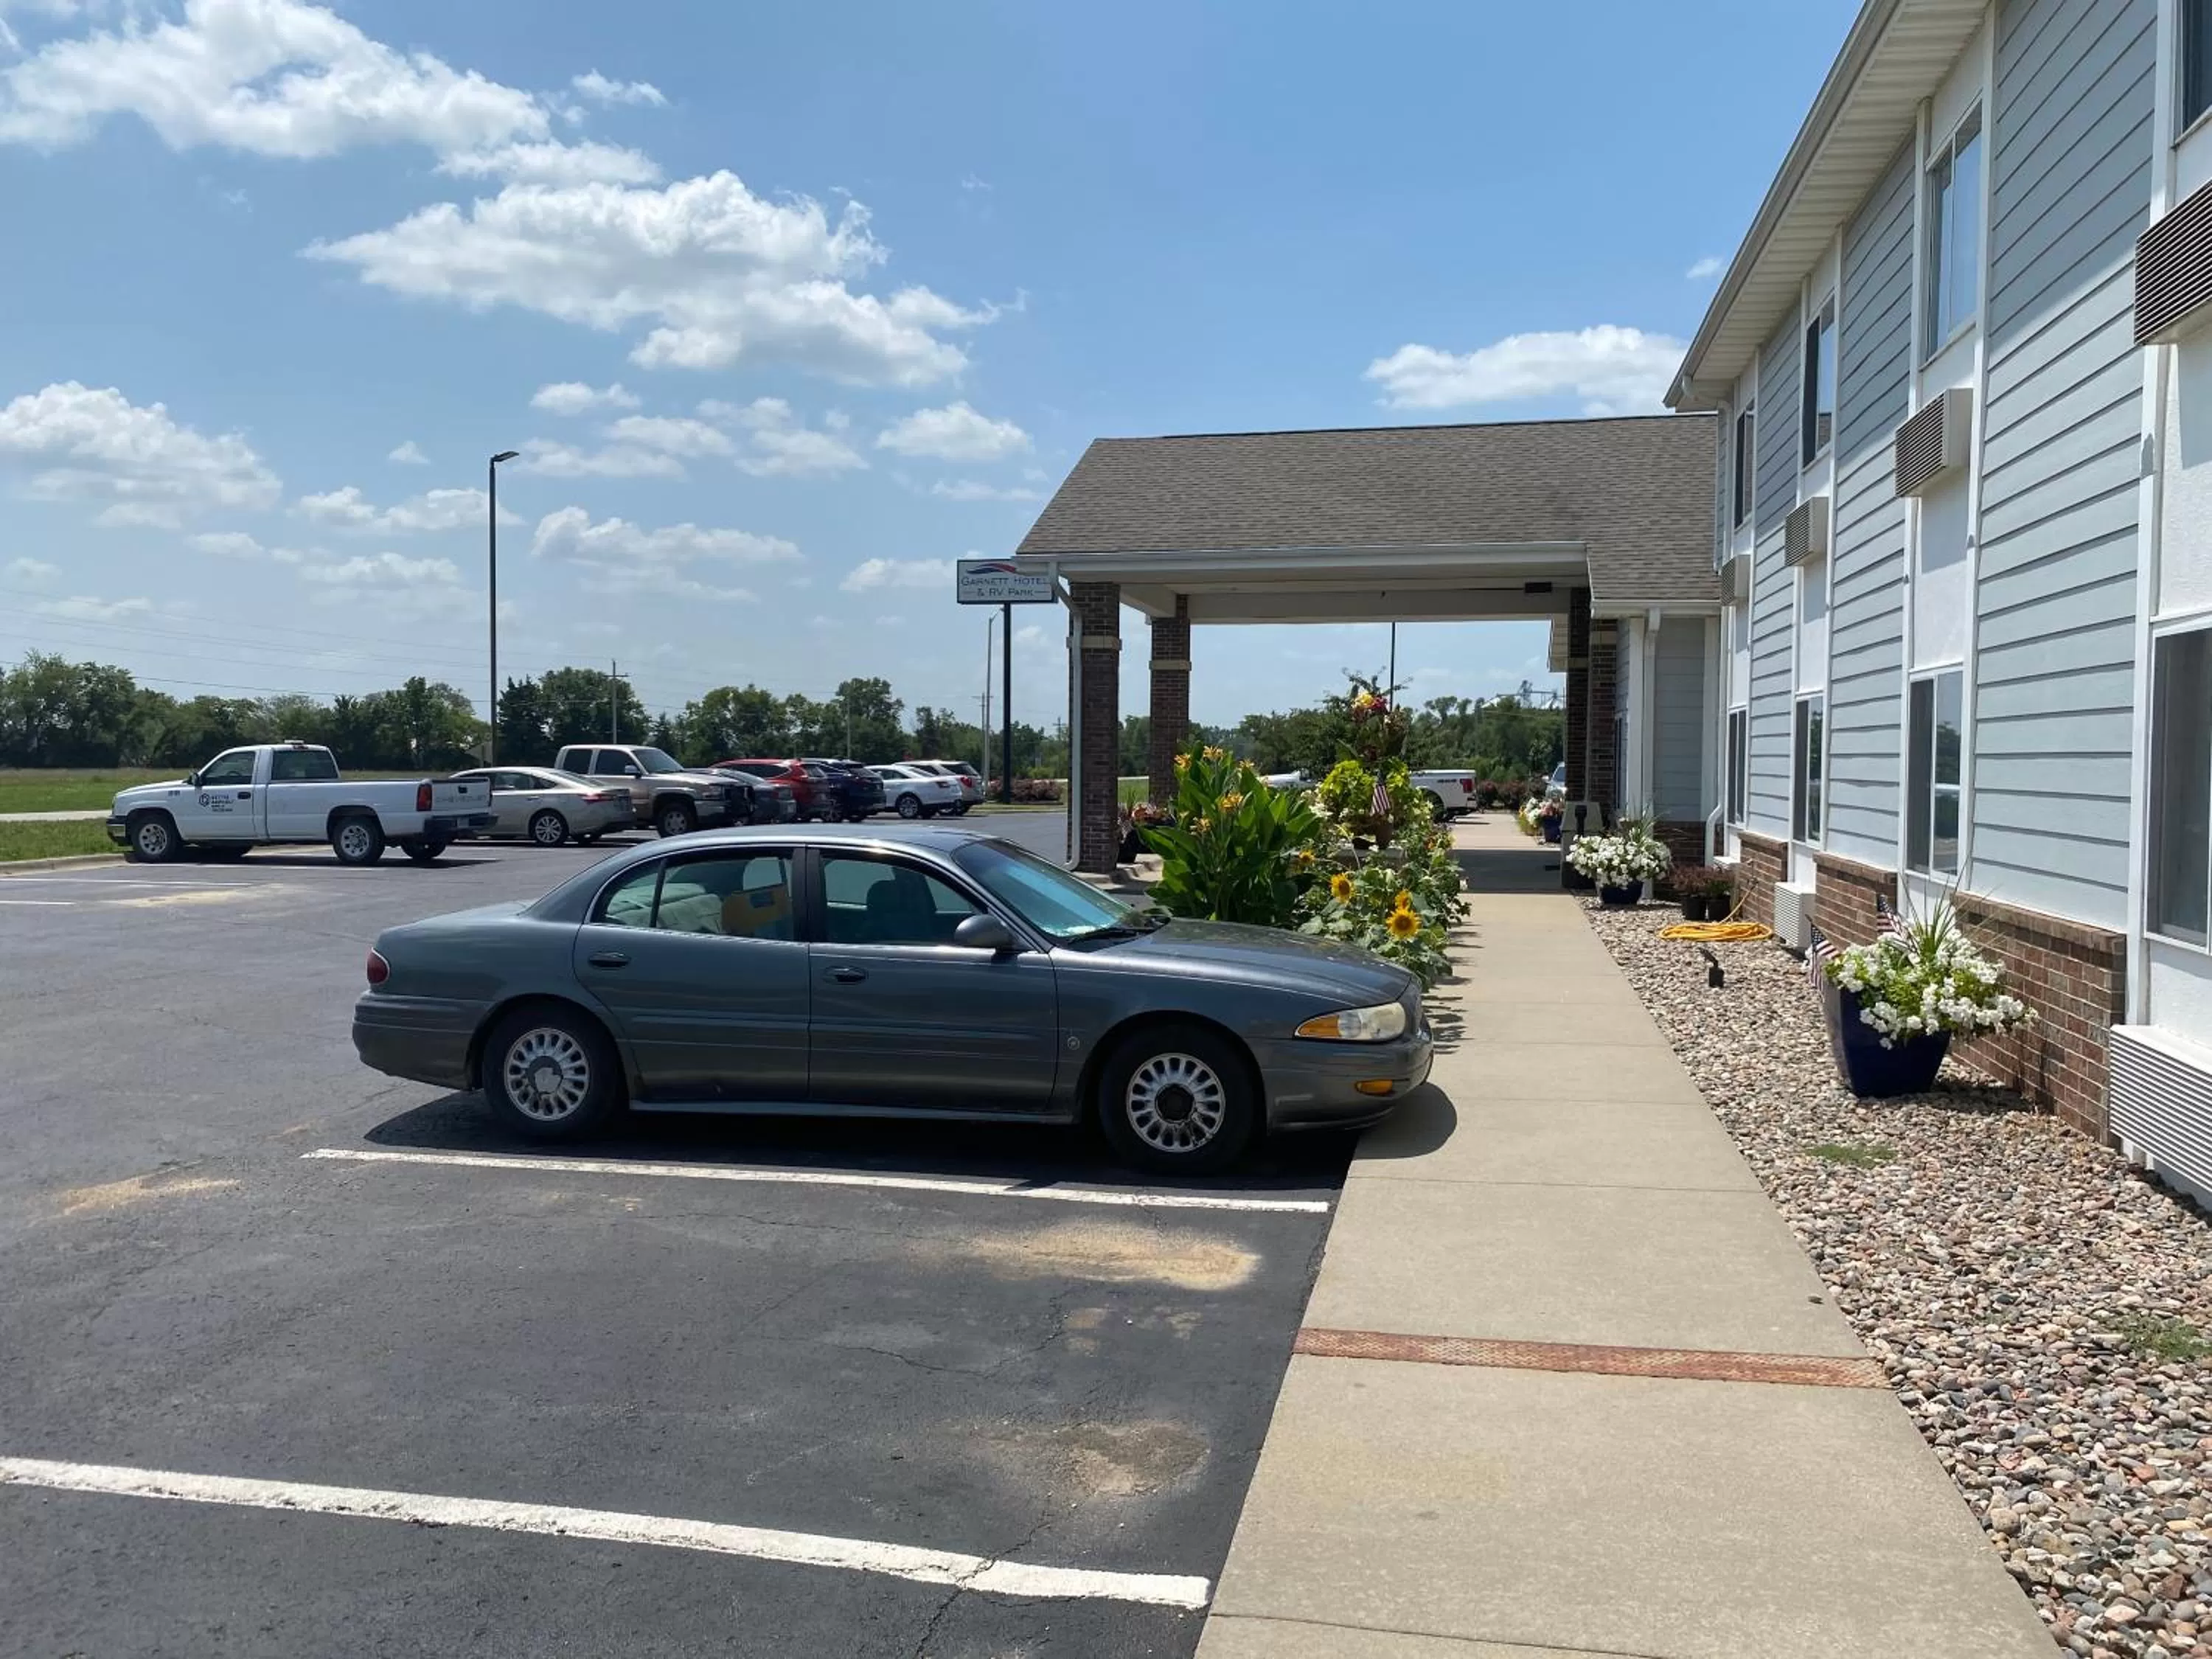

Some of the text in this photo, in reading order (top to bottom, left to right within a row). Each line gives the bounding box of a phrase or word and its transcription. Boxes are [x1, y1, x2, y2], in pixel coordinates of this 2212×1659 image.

[961, 576, 1048, 586] GARNETT HOTEL
[977, 588, 1034, 597] & RV PARK
